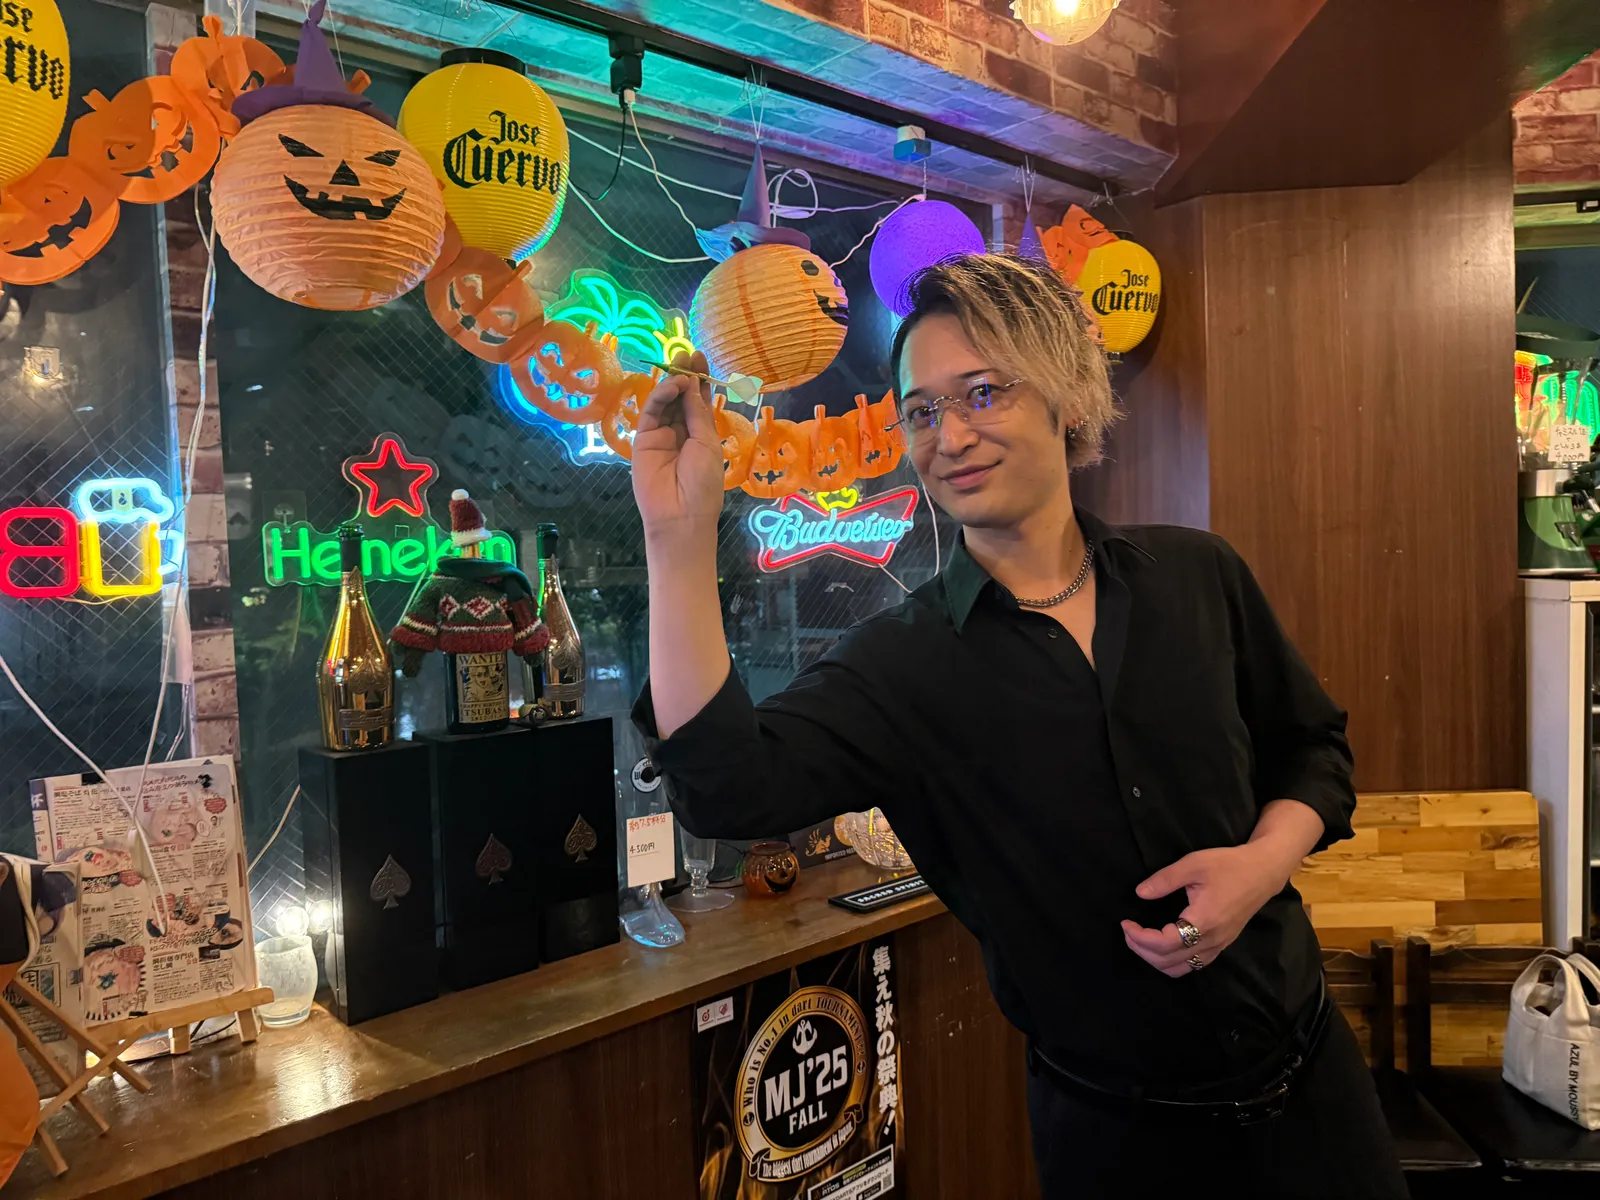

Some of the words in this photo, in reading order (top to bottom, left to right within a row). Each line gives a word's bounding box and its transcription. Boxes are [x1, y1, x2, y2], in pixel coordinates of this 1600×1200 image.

[0, 2, 33, 32] se
[0, 35, 64, 100] rvo
[488, 110, 541, 147] Jose
[443, 128, 560, 195] Cuervo
[1121, 268, 1150, 289] Jose
[1091, 281, 1159, 316] Cuervo
[755, 508, 912, 550] Budweiser
[270, 526, 513, 580] Henekn
[743, 1077, 755, 1108] Who
[750, 1059, 761, 1072] is
[757, 1027, 779, 1057] No.1
[779, 1013, 789, 1029] in
[791, 998, 811, 1017] dart
[872, 946, 898, 1135] 集え秋の祭典!
[1569, 1042, 1580, 1067] AZUL
[764, 1045, 848, 1122] MJ'25
[1568, 1070, 1578, 1084] BY
[789, 1100, 828, 1135] FALL
